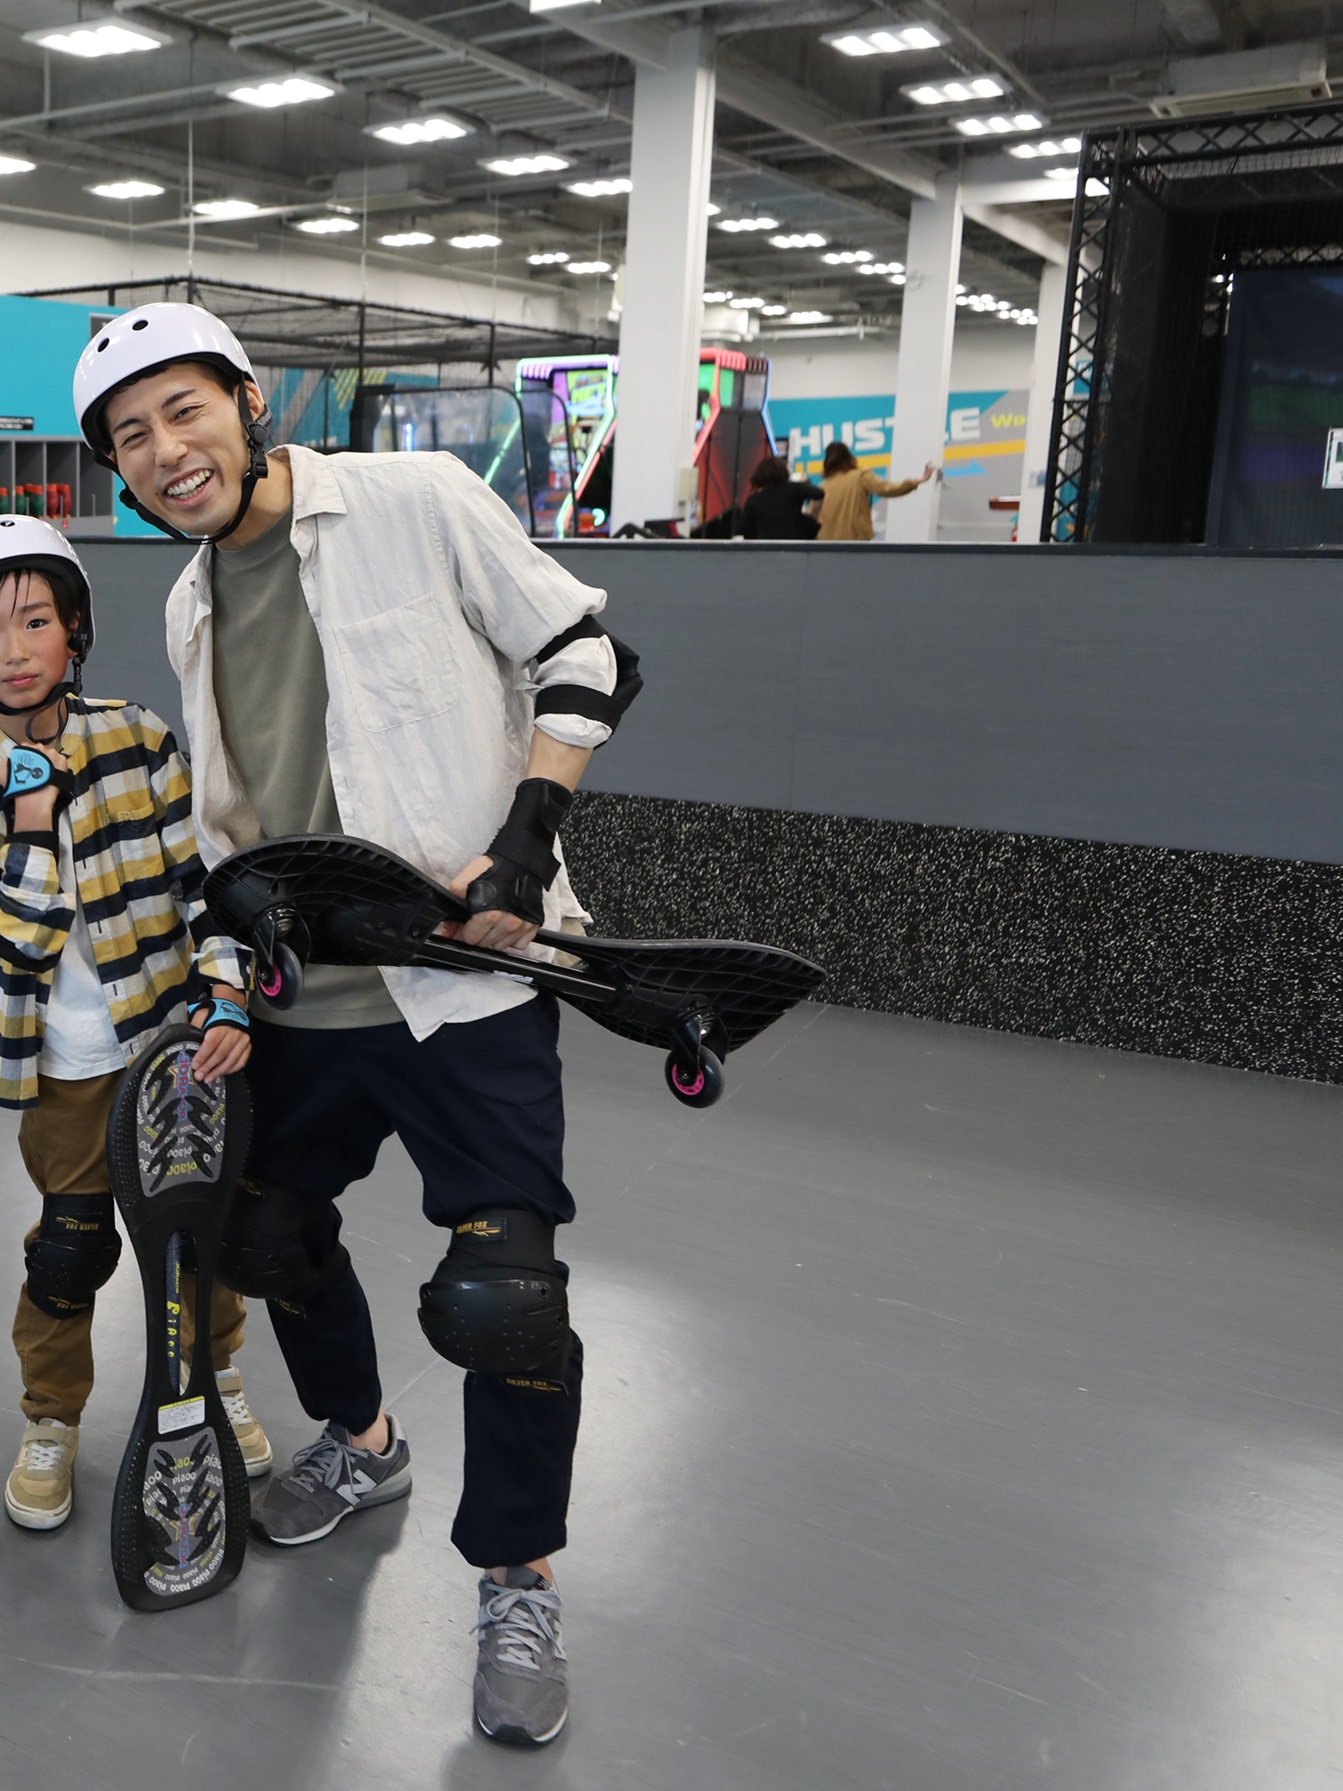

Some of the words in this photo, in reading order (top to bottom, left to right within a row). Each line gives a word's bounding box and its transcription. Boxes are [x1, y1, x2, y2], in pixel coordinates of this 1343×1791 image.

[789, 407, 980, 457] HUSE
[474, 1220, 488, 1229] FOX
[172, 1472, 196, 1486] piaoo
[205, 1471, 223, 1486] iaoo
[192, 1568, 210, 1586] piaoo
